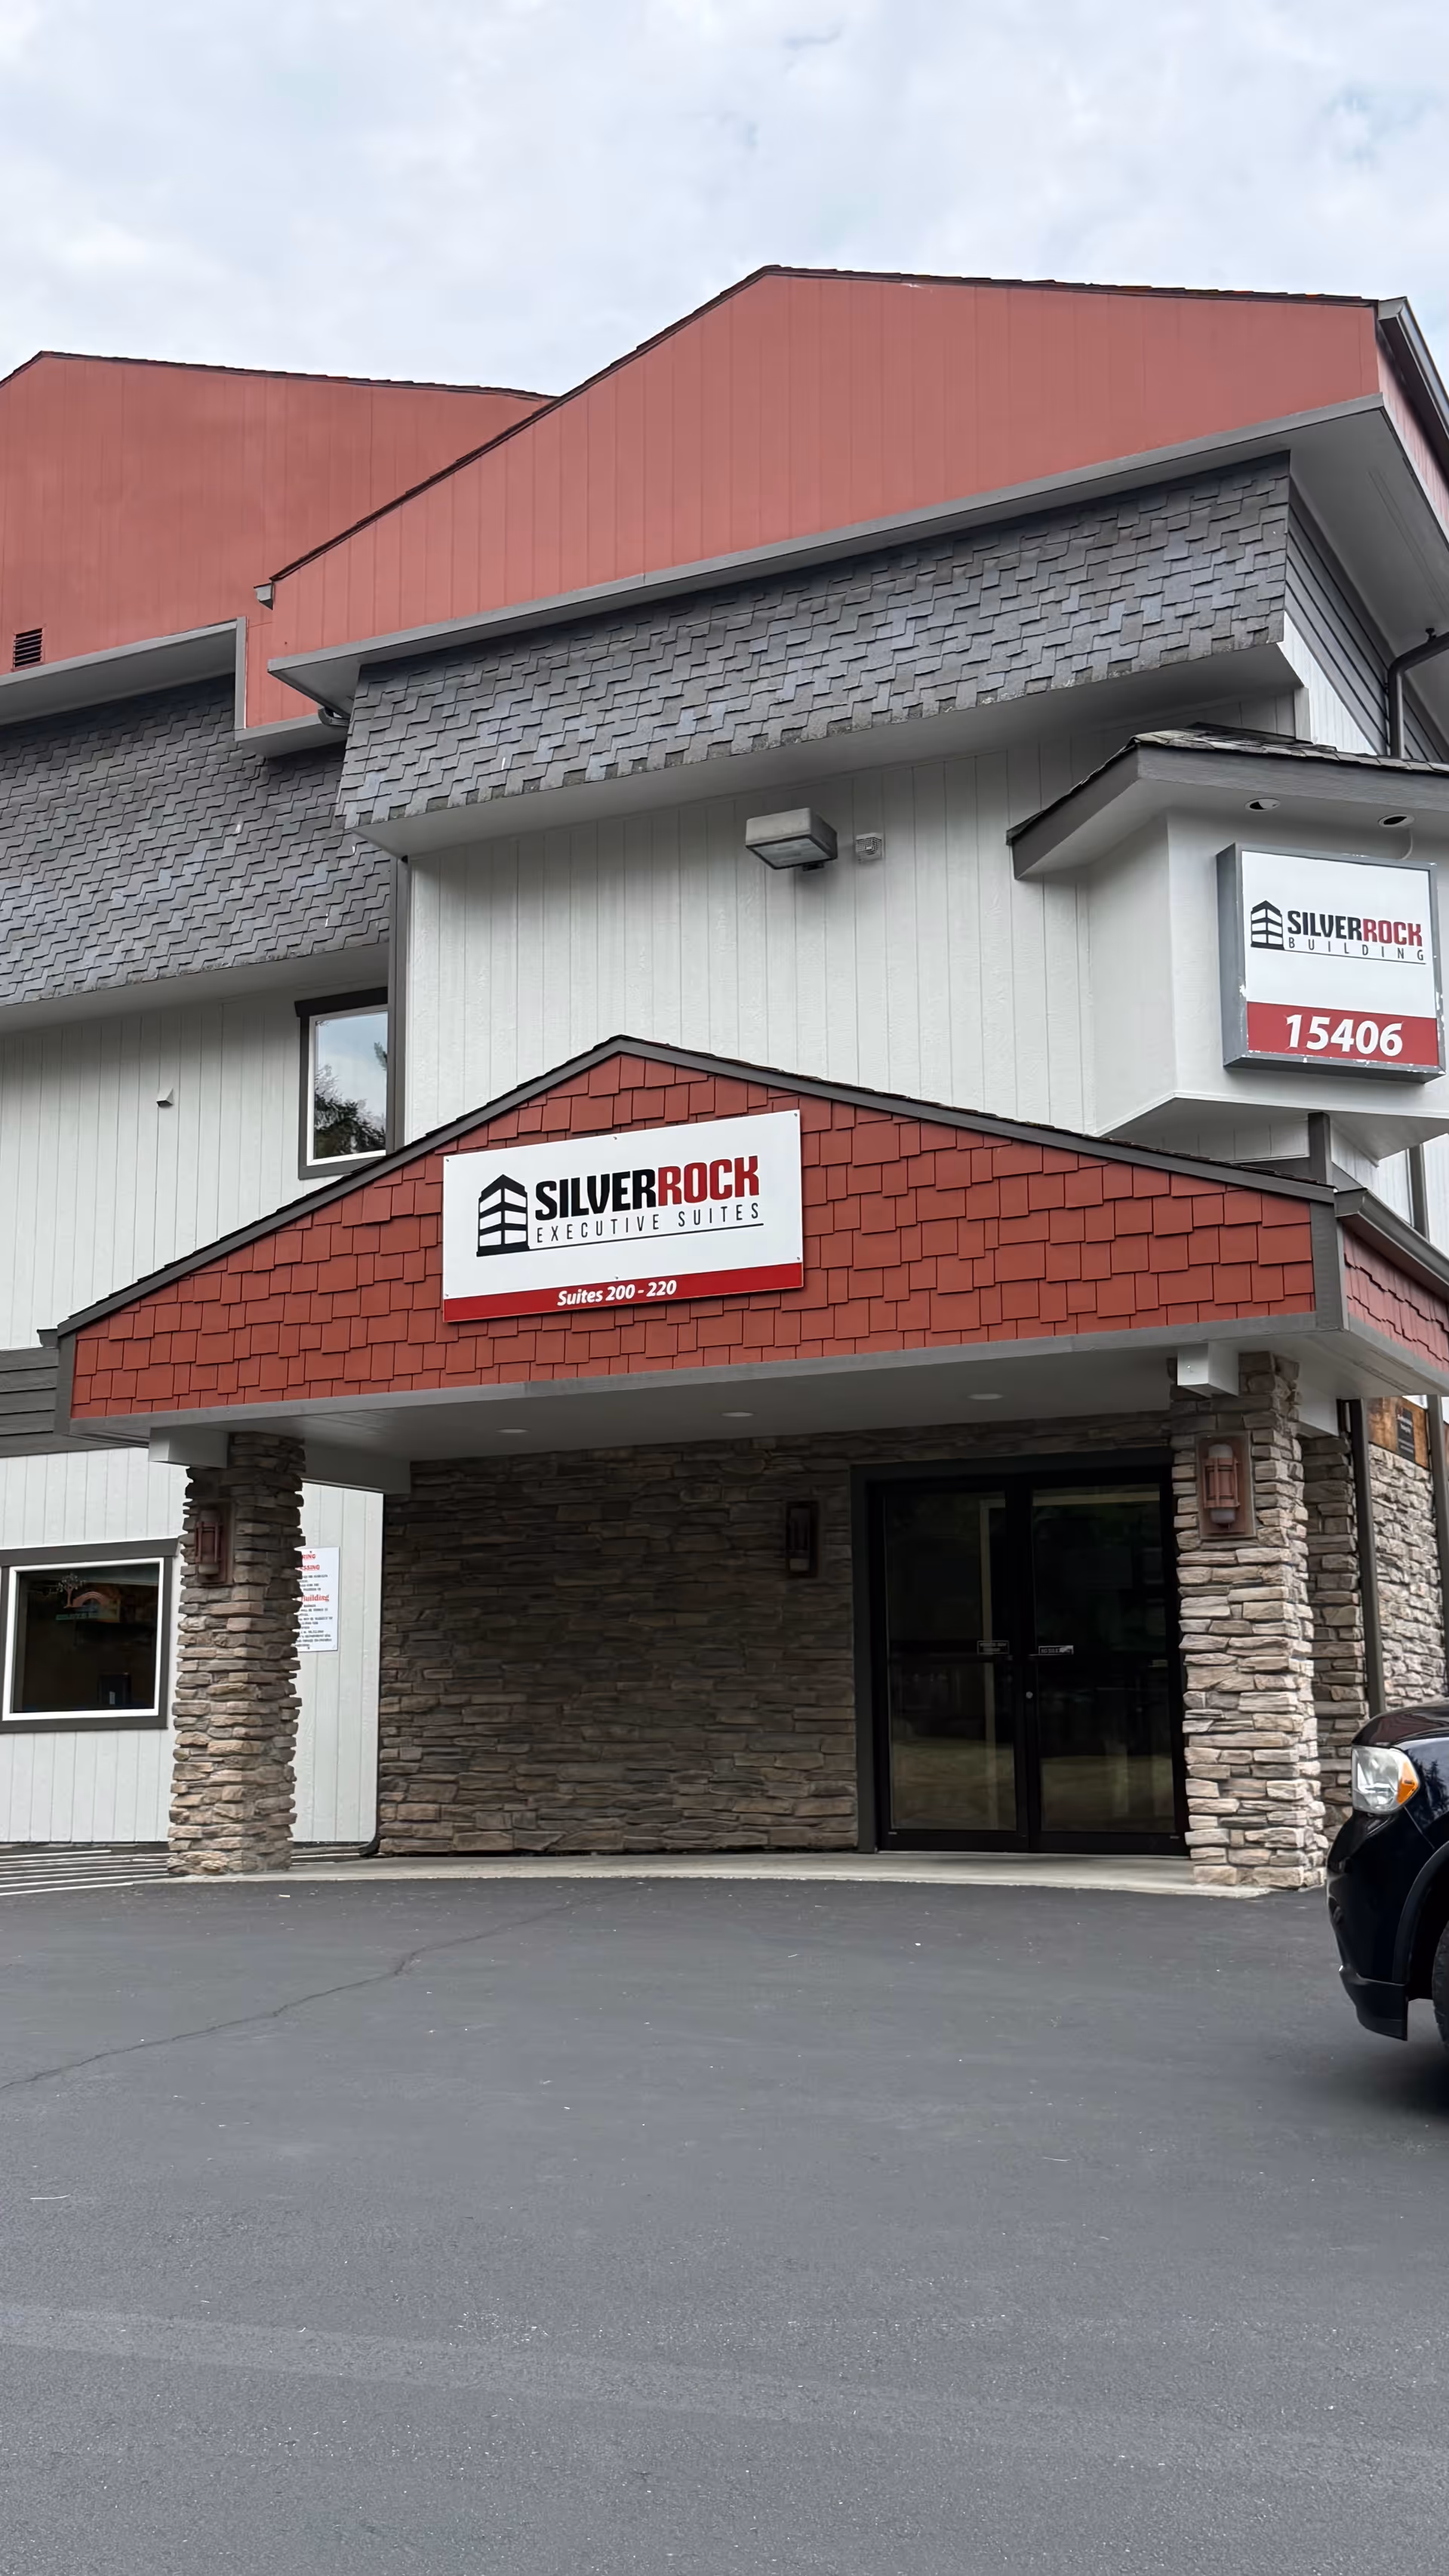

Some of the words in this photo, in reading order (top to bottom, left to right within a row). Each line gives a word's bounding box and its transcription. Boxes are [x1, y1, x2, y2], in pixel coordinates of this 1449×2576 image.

[1287, 910, 1423, 946] SILVERROCK
[1288, 937, 1423, 961] BUILDING
[1286, 1014, 1403, 1057] 15406
[535, 1156, 759, 1220] SILVERROCK
[537, 1214, 659, 1242] EXECUTIVE
[678, 1202, 759, 1226] SUITES
[557, 1288, 604, 1306] Suites
[605, 1284, 636, 1301] 200
[646, 1279, 677, 1297] 220
